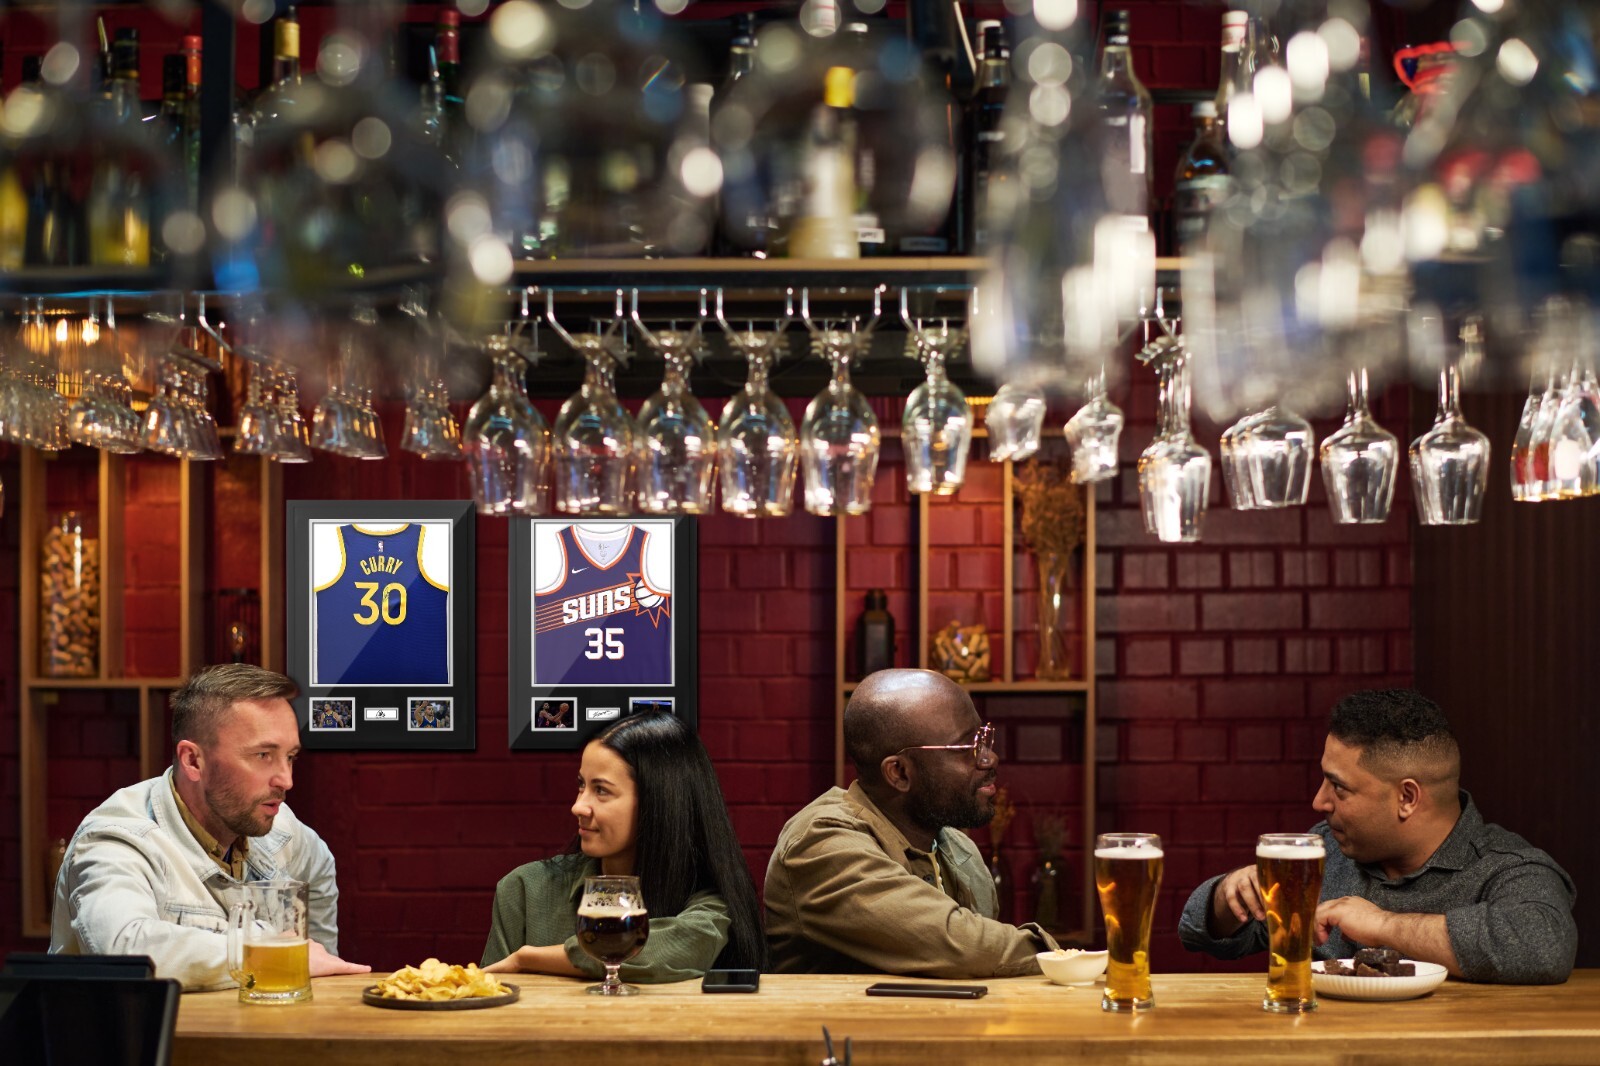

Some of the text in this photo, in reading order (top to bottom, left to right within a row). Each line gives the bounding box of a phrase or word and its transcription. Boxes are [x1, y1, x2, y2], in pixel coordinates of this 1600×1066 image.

[360, 556, 403, 575] CURRY
[353, 582, 407, 625] 30
[584, 627, 625, 660] 35
